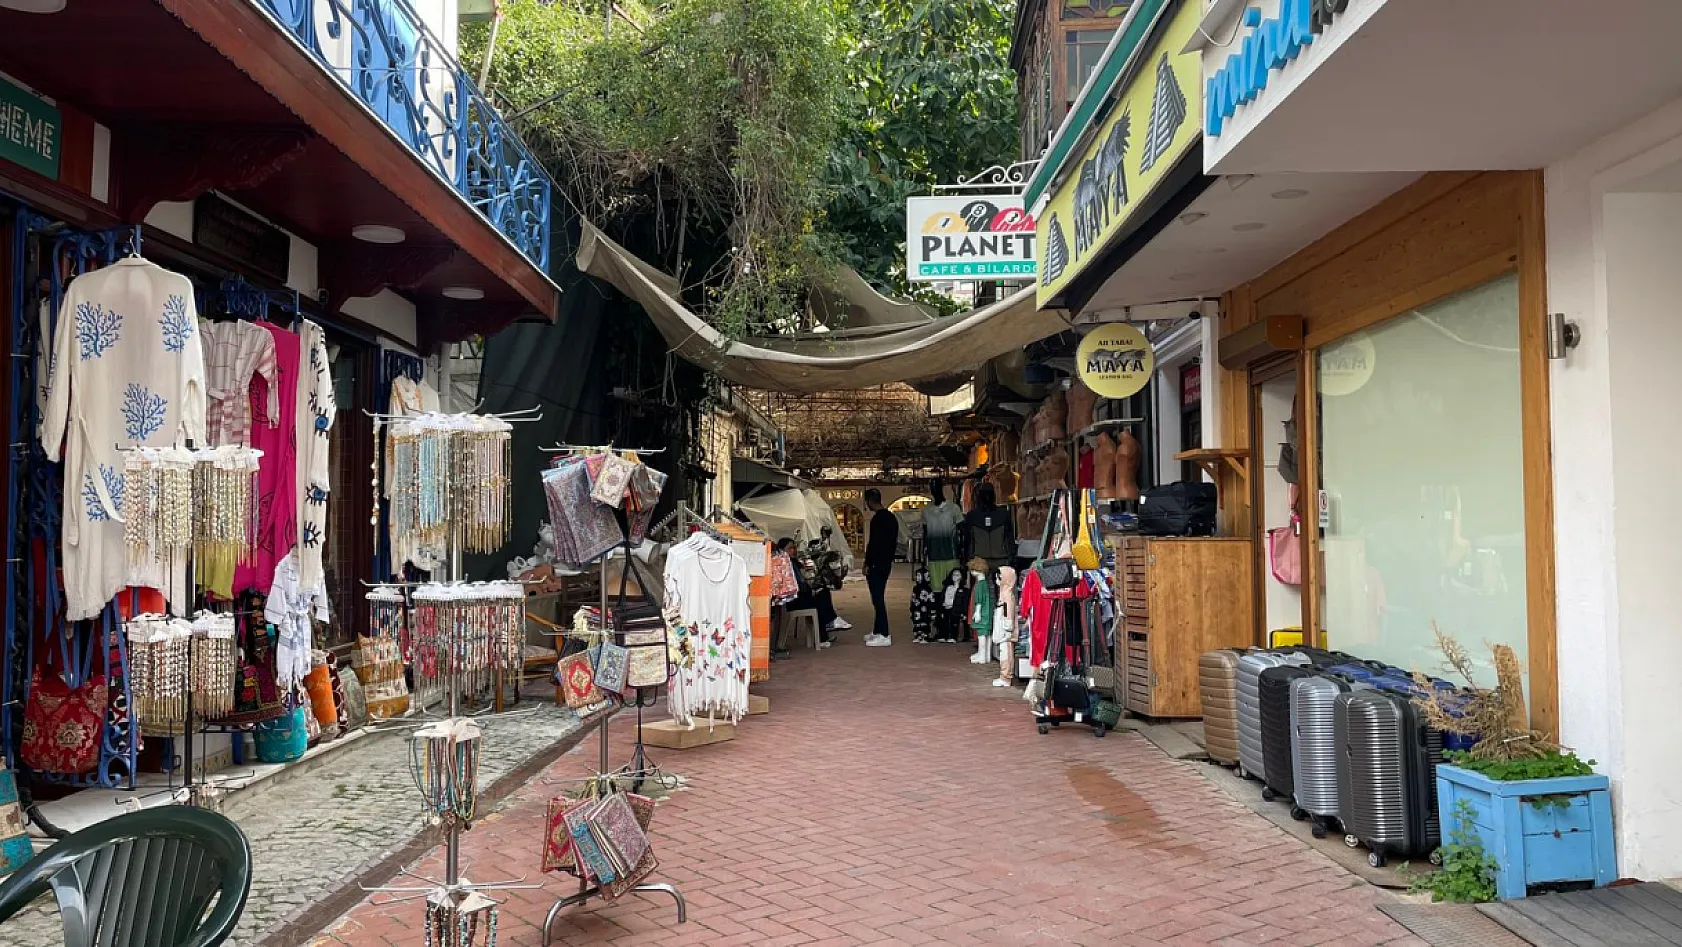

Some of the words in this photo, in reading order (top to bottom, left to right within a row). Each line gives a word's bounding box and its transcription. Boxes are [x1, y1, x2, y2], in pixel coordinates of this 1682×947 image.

[1075, 160, 1129, 262] MAYA
[922, 234, 1036, 261] PLANET
[920, 265, 957, 275] CAFE
[963, 264, 972, 274] &
[1086, 359, 1144, 373] MAYA
